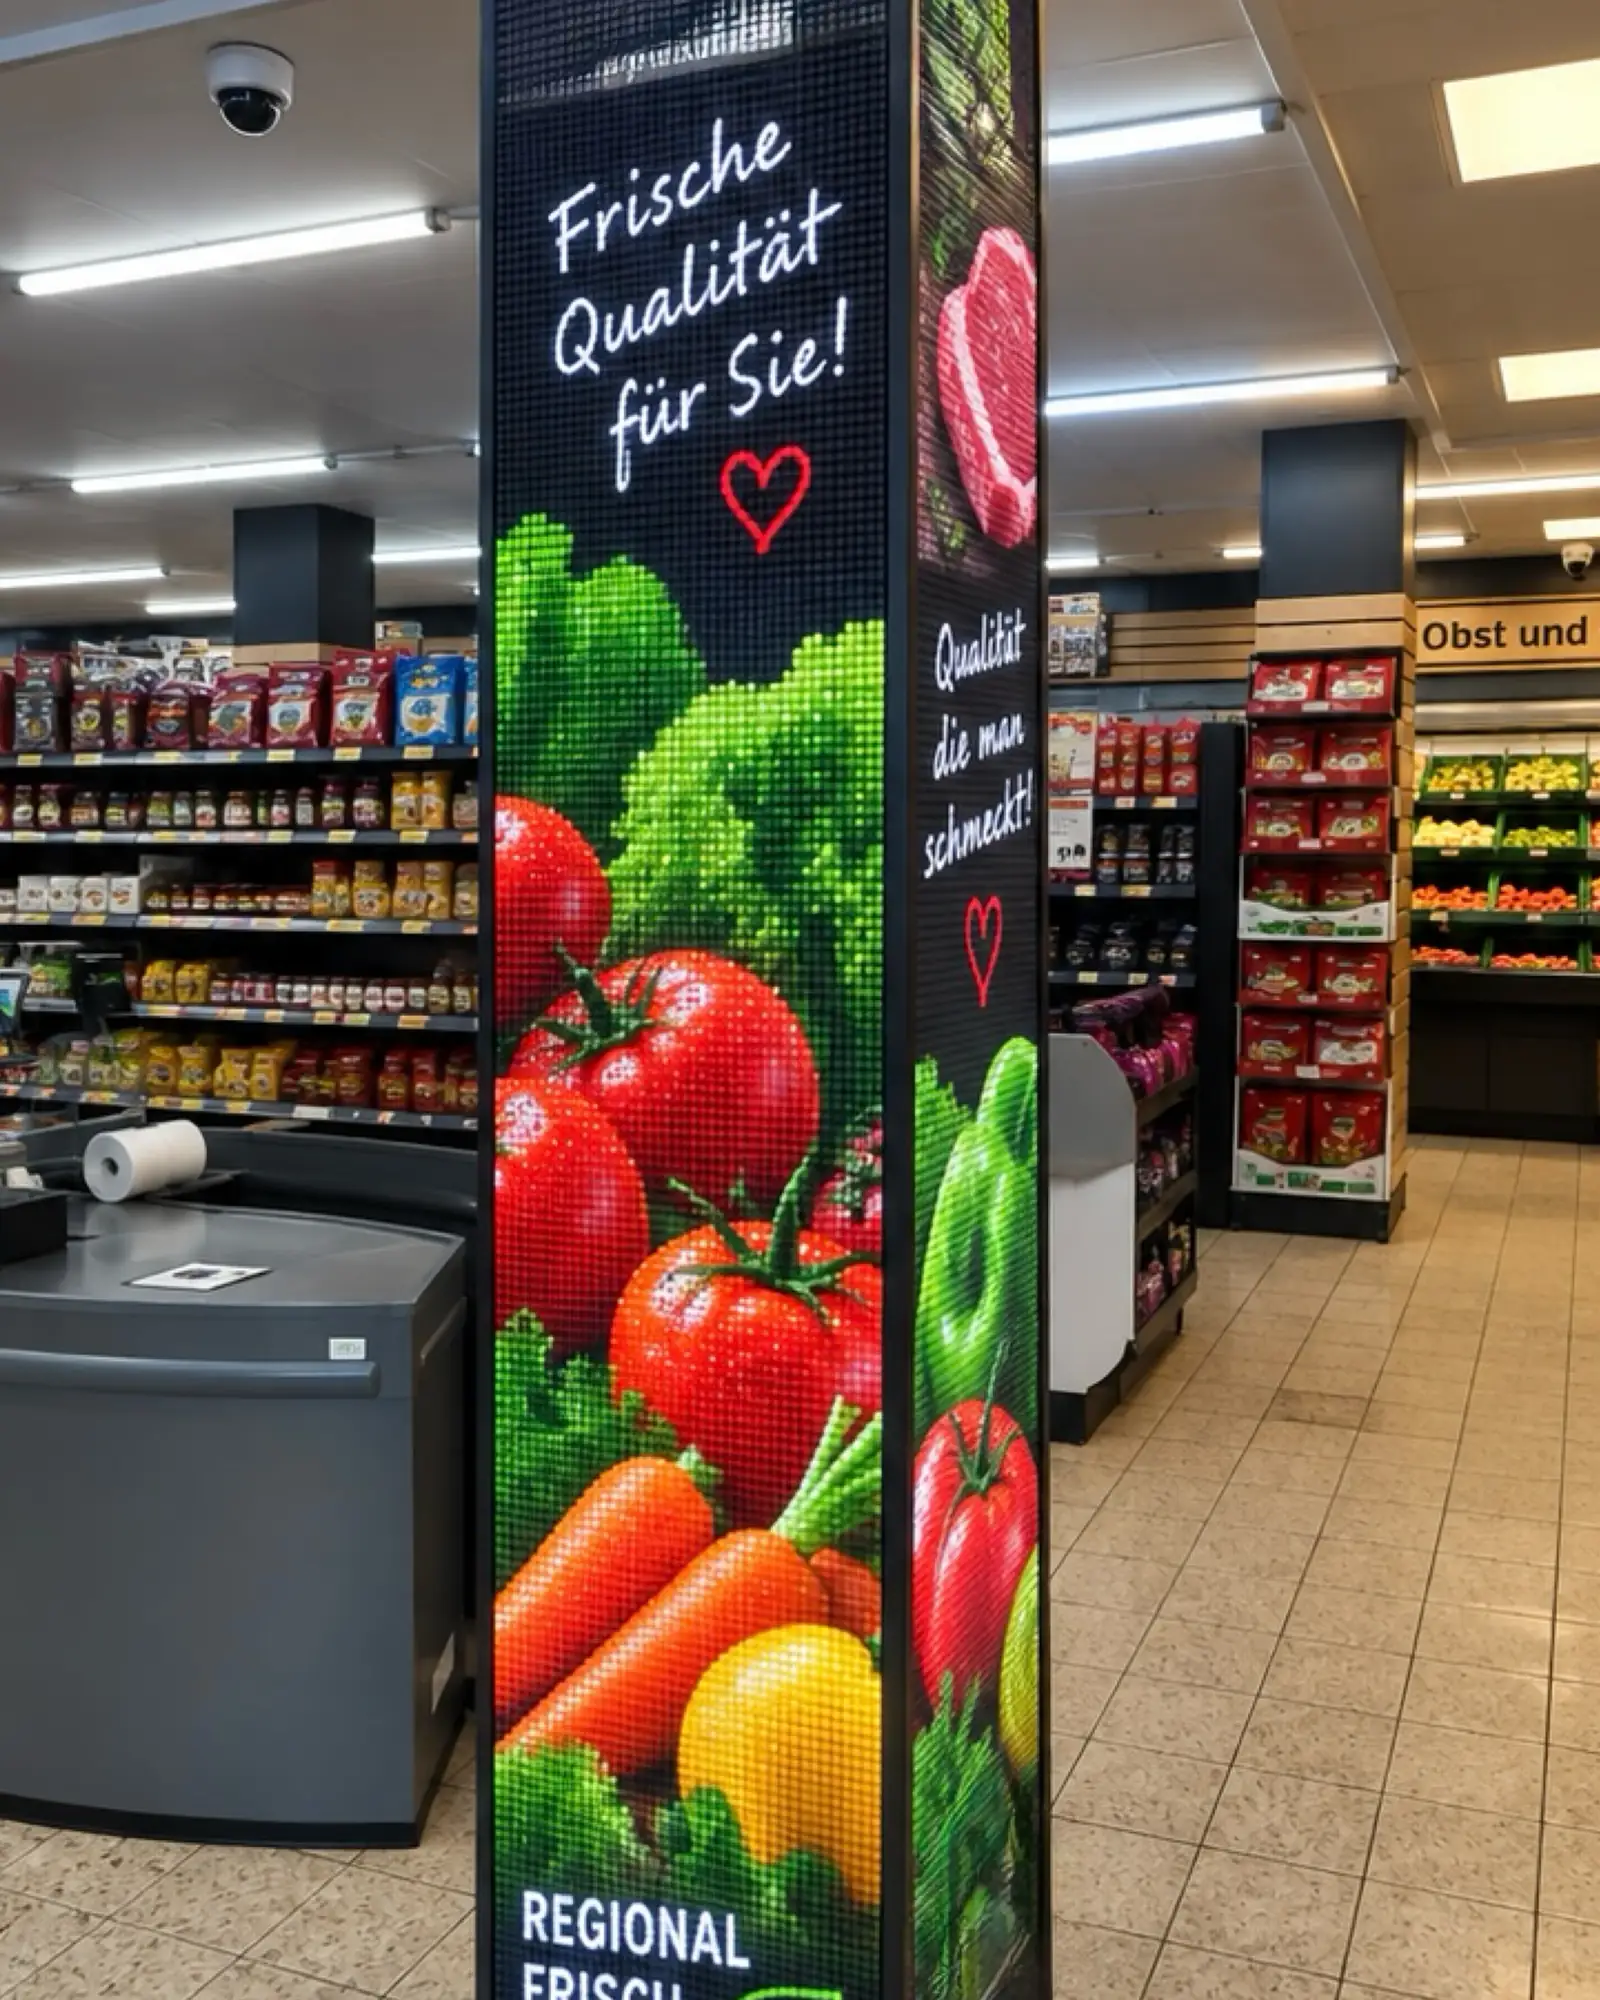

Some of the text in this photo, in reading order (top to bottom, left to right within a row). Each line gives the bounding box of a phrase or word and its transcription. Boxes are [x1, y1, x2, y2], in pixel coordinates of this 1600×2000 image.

[547, 117, 791, 274] Frische
[552, 186, 843, 376] Qualität
[609, 296, 847, 493] für Sie!
[1422, 615, 1588, 650] Obst und
[933, 712, 1025, 780] die man
[923, 768, 1033, 879] schmeckt!
[523, 1890, 750, 1969] REGIONAL
